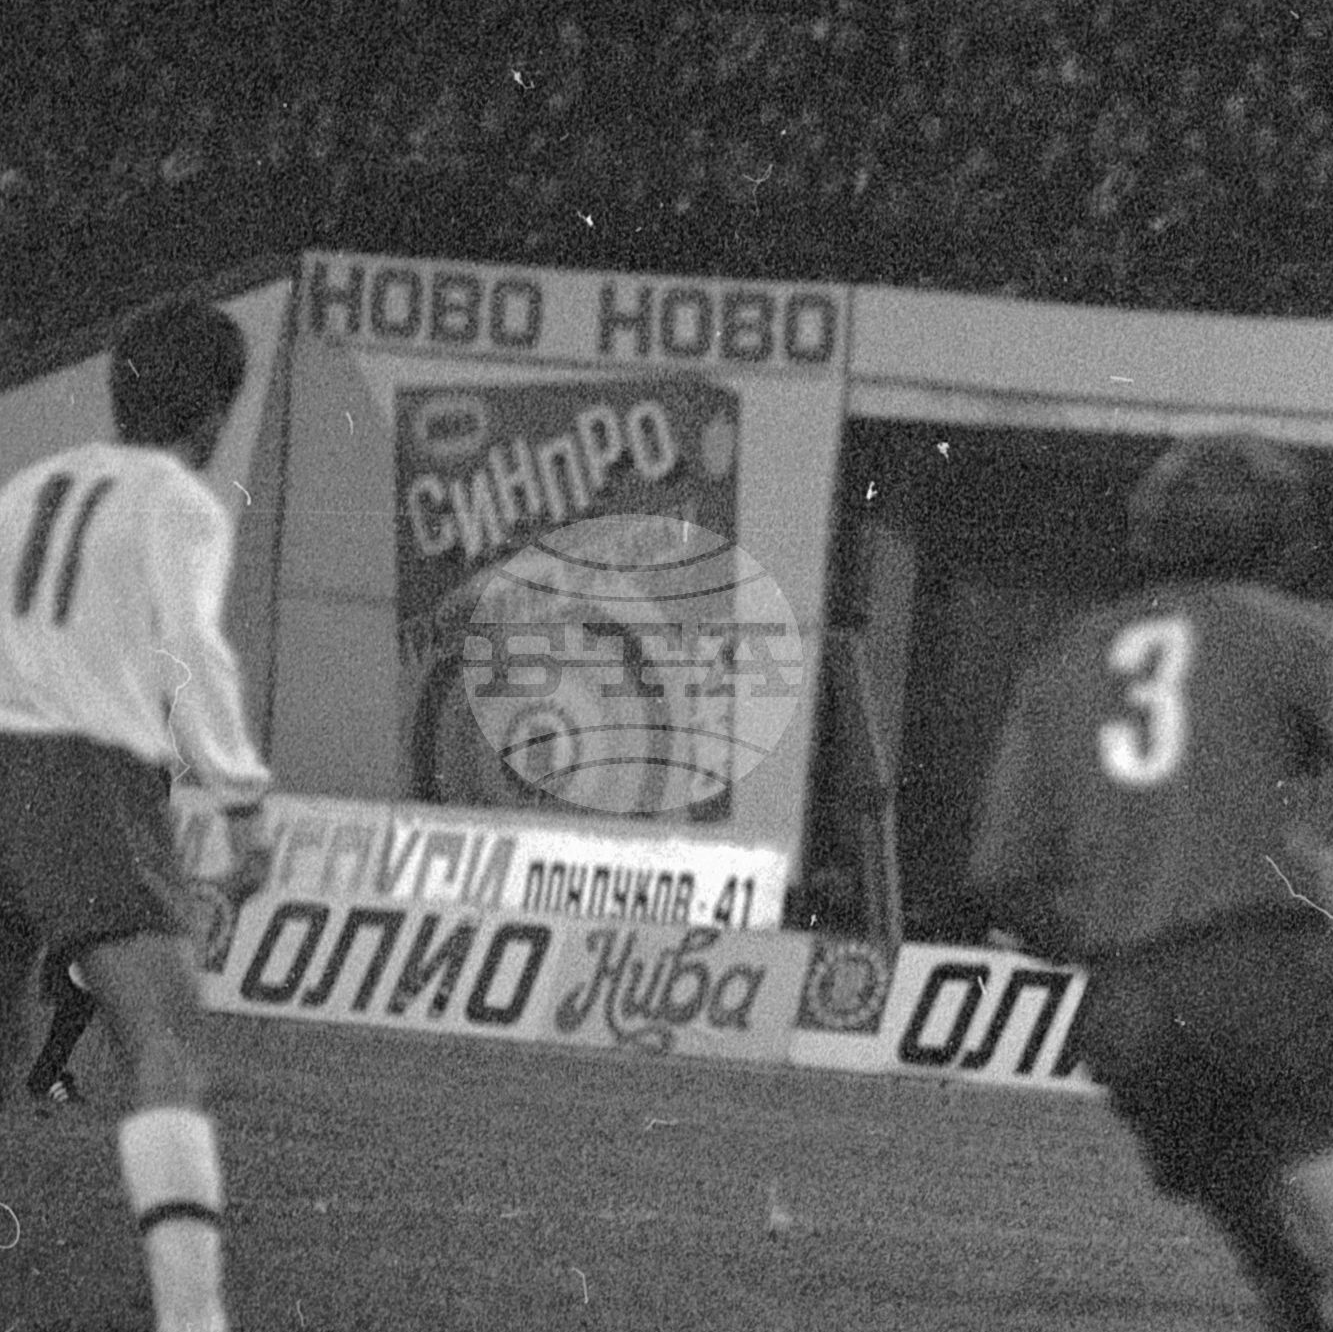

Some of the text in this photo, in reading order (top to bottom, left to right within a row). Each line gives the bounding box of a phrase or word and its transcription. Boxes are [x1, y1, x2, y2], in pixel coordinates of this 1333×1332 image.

[308, 264, 839, 365] НОВО НОВО
[12, 472, 115, 628] 11
[407, 398, 678, 560] СИНПРО
[1098, 614, 1193, 787] 3
[238, 900, 553, 1027] ОЛИО
